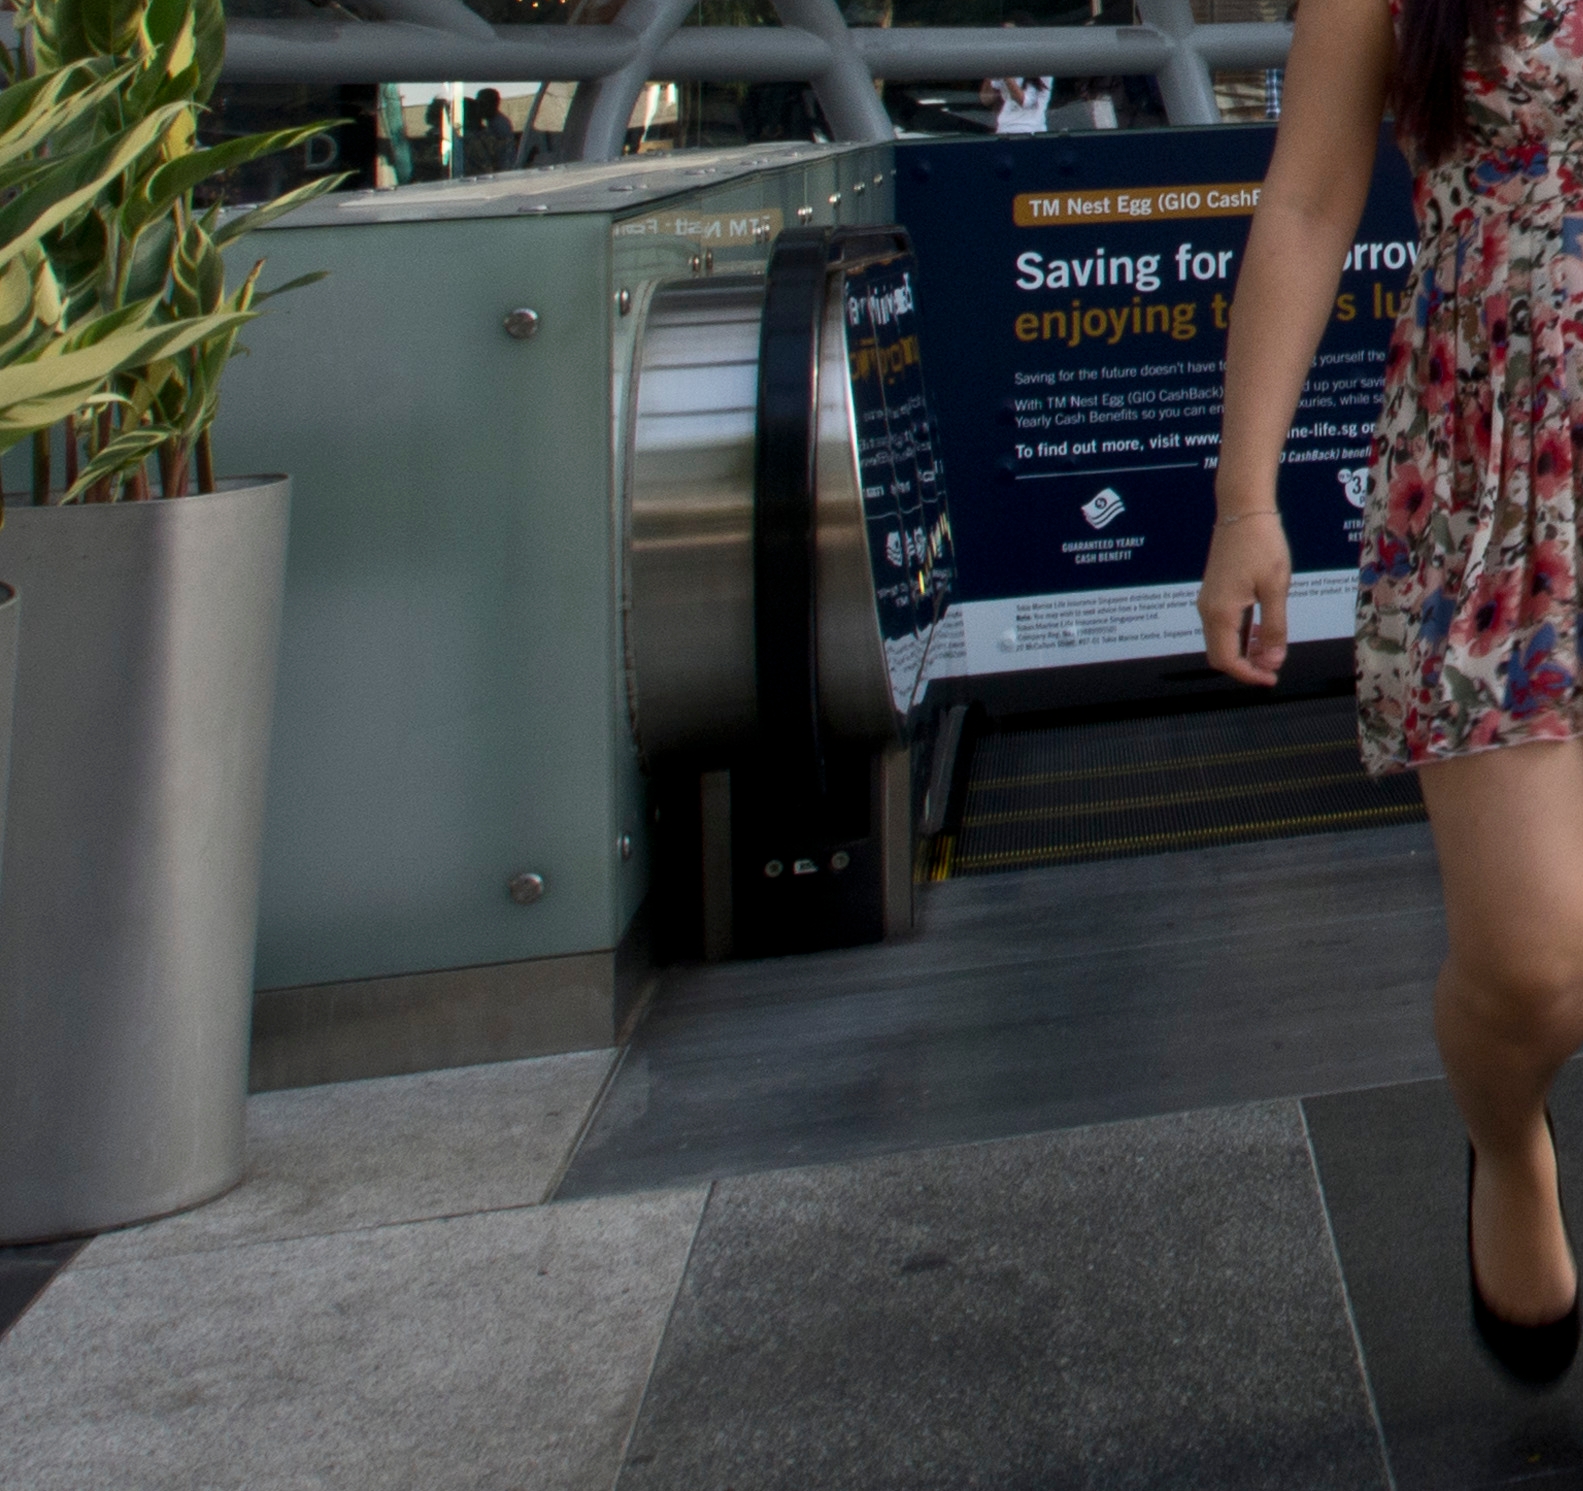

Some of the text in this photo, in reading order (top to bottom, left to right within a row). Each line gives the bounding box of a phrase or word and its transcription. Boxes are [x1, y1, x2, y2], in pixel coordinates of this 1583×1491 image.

[1029, 199, 1060, 217] TM
[1067, 197, 1110, 215] Nest
[1118, 195, 1152, 215] Egg
[1158, 192, 1200, 213] (GIO
[1016, 248, 1161, 292] Saving
[1175, 243, 1233, 281] for
[1014, 296, 1197, 347] enjoying
[1015, 371, 1055, 386] Saving
[1058, 369, 1075, 381] for
[1078, 367, 1098, 380] the
[1101, 365, 1137, 379] future
[1140, 362, 1184, 377] doesn't
[1187, 360, 1215, 374] have
[1319, 350, 1365, 367] yourself
[1367, 350, 1386, 361] the
[1015, 399, 1042, 412] With
[1047, 396, 1067, 409] TM
[1070, 394, 1098, 408] Nest
[1102, 393, 1124, 408] Egg
[1128, 390, 1156, 405] (GIO
[1159, 386, 1224, 402] CashBack)
[1313, 379, 1330, 393] up
[1332, 377, 1358, 391] your
[1015, 414, 1051, 429] Yearly
[1055, 411, 1085, 425] Cash
[1089, 408, 1138, 424] Benefits
[1141, 408, 1155, 419] so
[1158, 406, 1180, 421] you
[1183, 404, 1206, 417] can
[1340, 391, 1369, 405] while
[1015, 444, 1033, 459] To
[1037, 441, 1068, 457] find
[1072, 439, 1097, 455] out
[1102, 436, 1144, 453] more,
[1149, 433, 1180, 449] visit
[1203, 456, 1219, 470] TM
[1062, 536, 1145, 553] GUARANTEED YEARLY
[1075, 550, 1132, 564] CASH BENEFIT
